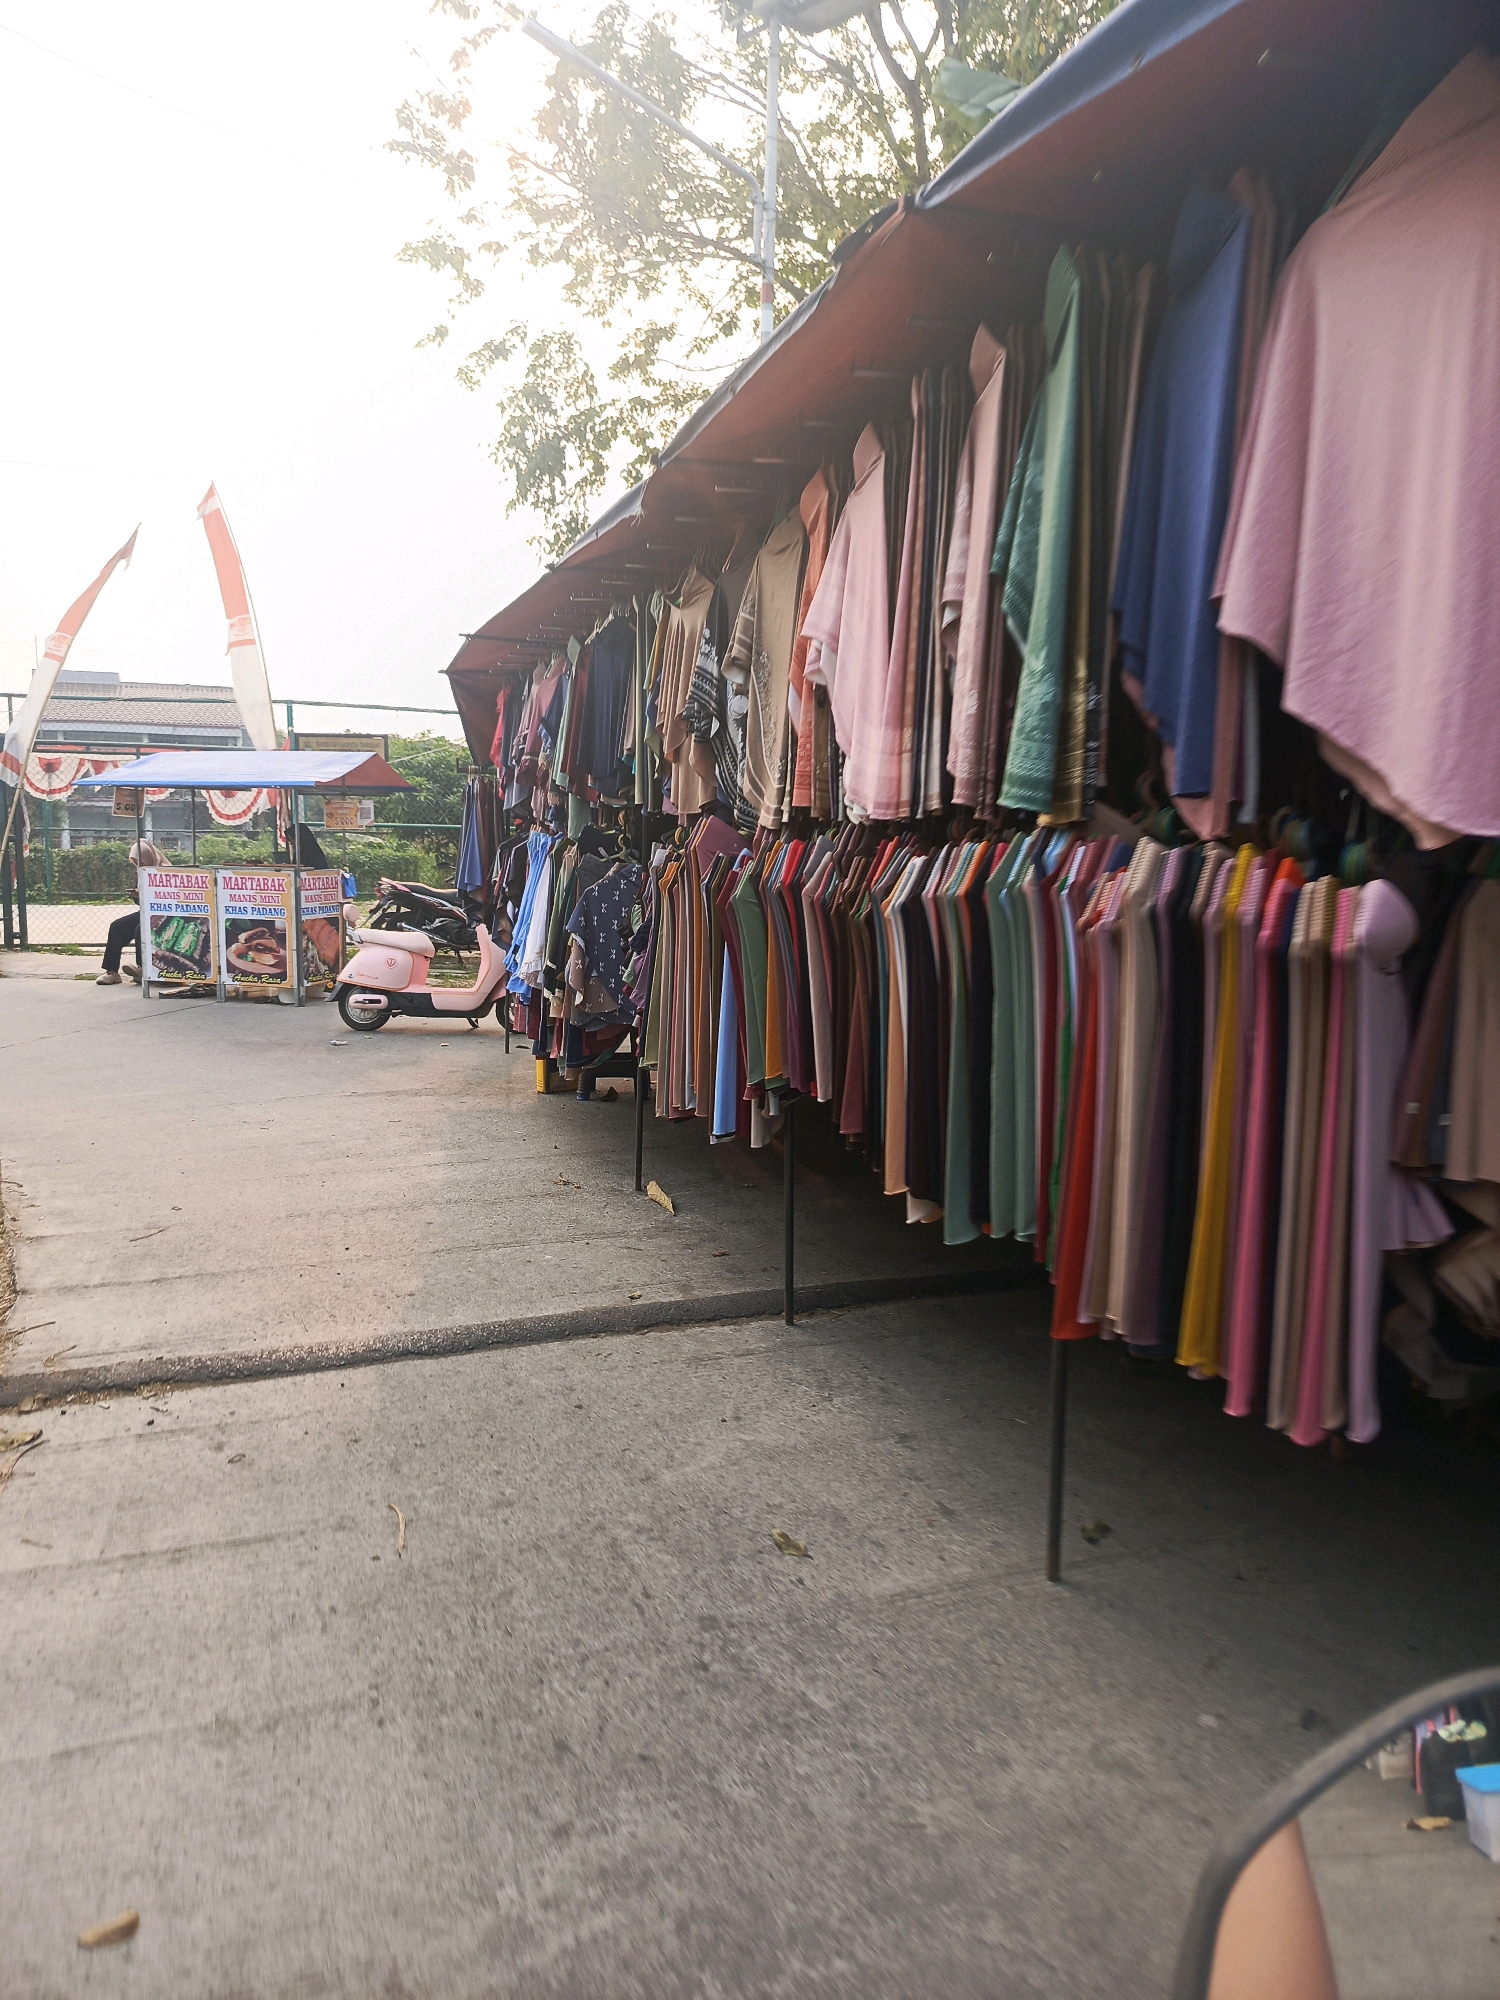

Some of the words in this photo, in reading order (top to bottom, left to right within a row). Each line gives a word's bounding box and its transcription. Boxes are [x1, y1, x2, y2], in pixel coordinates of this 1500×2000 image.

[334, 816, 355, 826] 5.000
[147, 873, 210, 889] MARTABAK
[222, 876, 287, 892] MARTABAK
[154, 890, 181, 901] MANIS
[183, 892, 204, 901] MINI
[229, 893, 258, 904] MANIS
[259, 895, 281, 905] MINI
[304, 894, 323, 903] MANIS
[149, 902, 173, 912] KHAS
[175, 903, 210, 914] PADANG
[224, 905, 249, 915] KHAS
[250, 906, 286, 917] PADANG
[318, 904, 340, 915] PADANG
[159, 968, 184, 979] Aneka
[185, 969, 207, 980] Rasa
[233, 973, 259, 983] Aneka
[259, 974, 282, 984] Rasa
